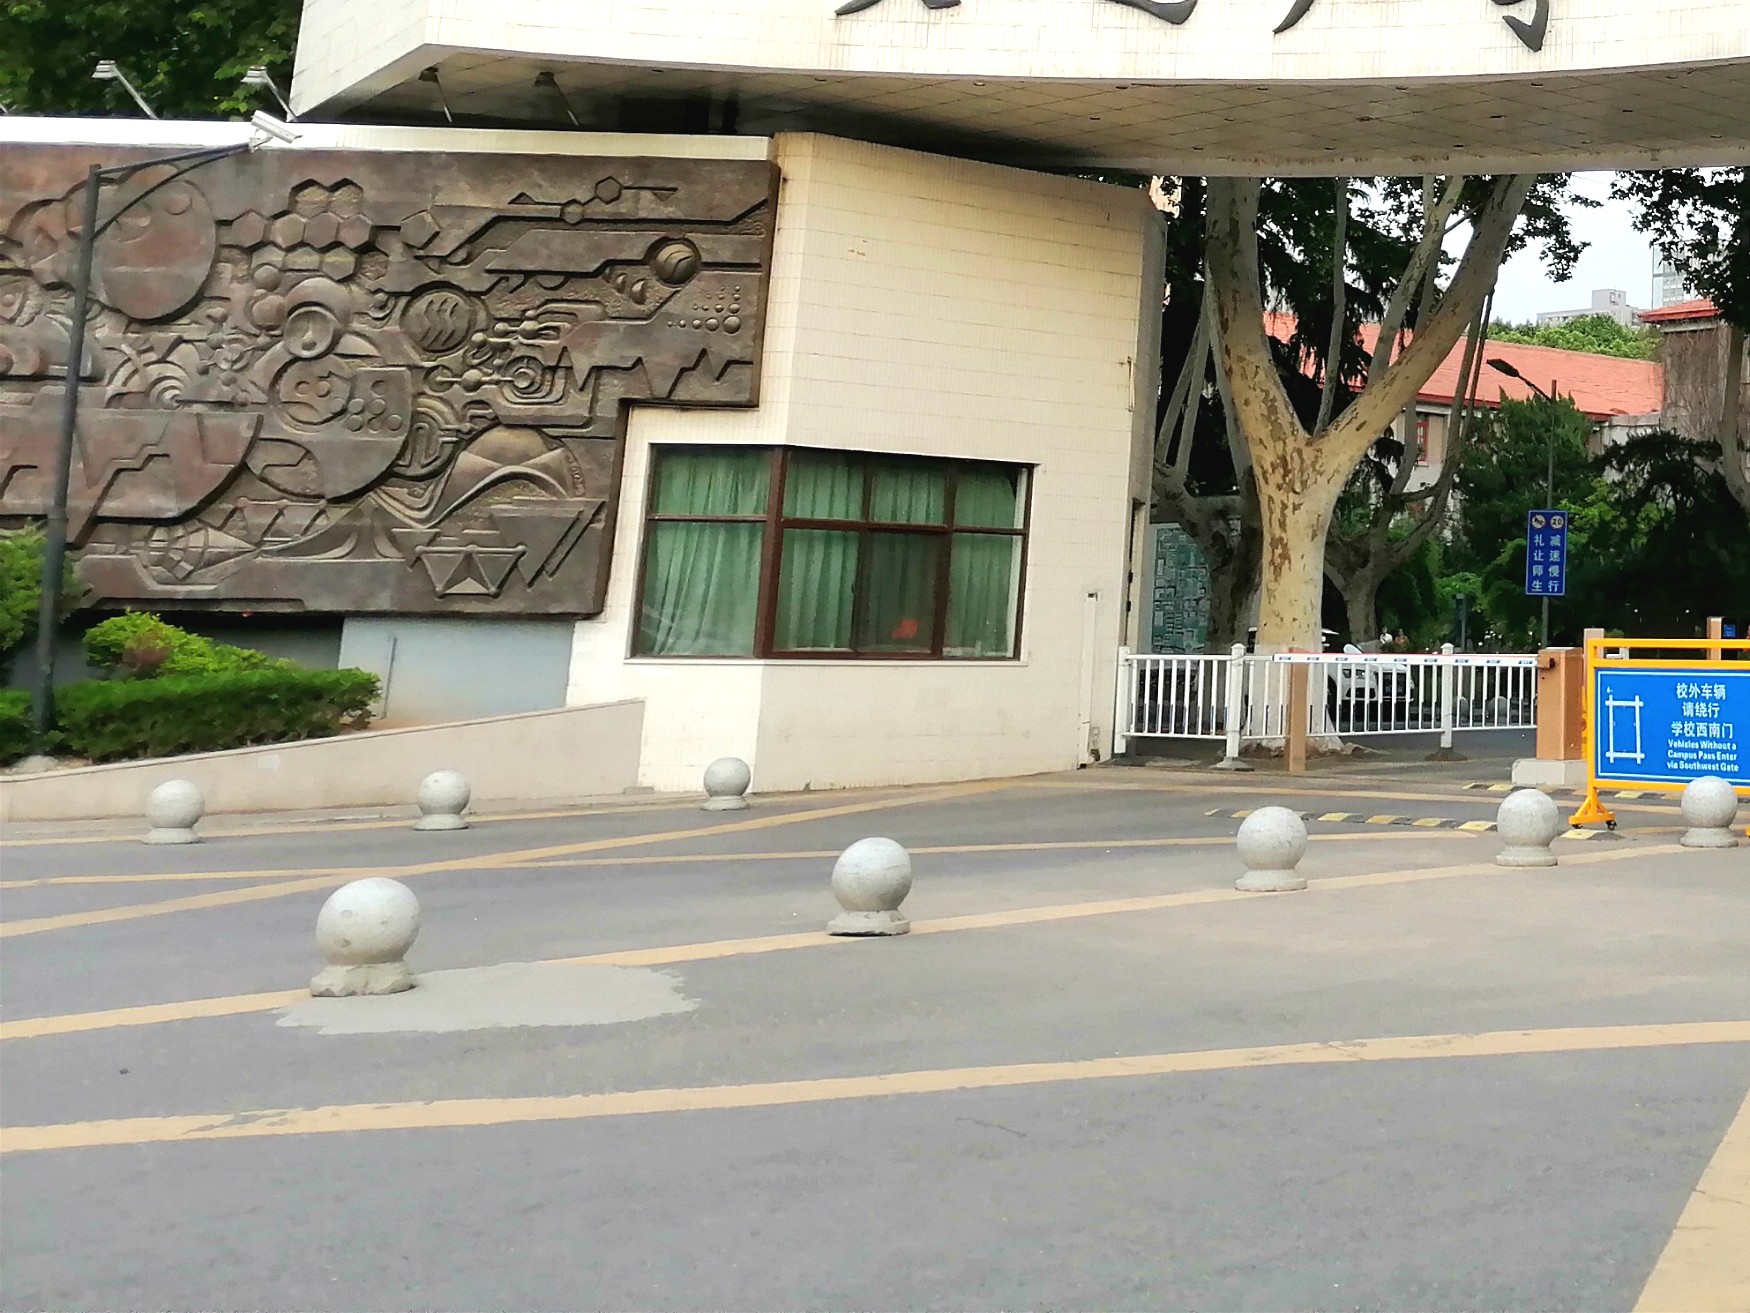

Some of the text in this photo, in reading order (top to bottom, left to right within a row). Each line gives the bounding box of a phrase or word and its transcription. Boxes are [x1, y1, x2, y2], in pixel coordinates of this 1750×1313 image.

[1531, 533, 1545, 592] 礼让师生
[1547, 534, 1562, 592] 减速慢行
[1676, 682, 1726, 700] 校外车辆
[1682, 702, 1720, 718] 请绕行
[1671, 721, 1733, 739] 学校西南门
[1667, 738, 1699, 749] Vehicles
[1700, 740, 1731, 750] Without
[1667, 749, 1738, 761] Campus Pass Enter
[1666, 760, 1740, 772] via Southwest Gate
